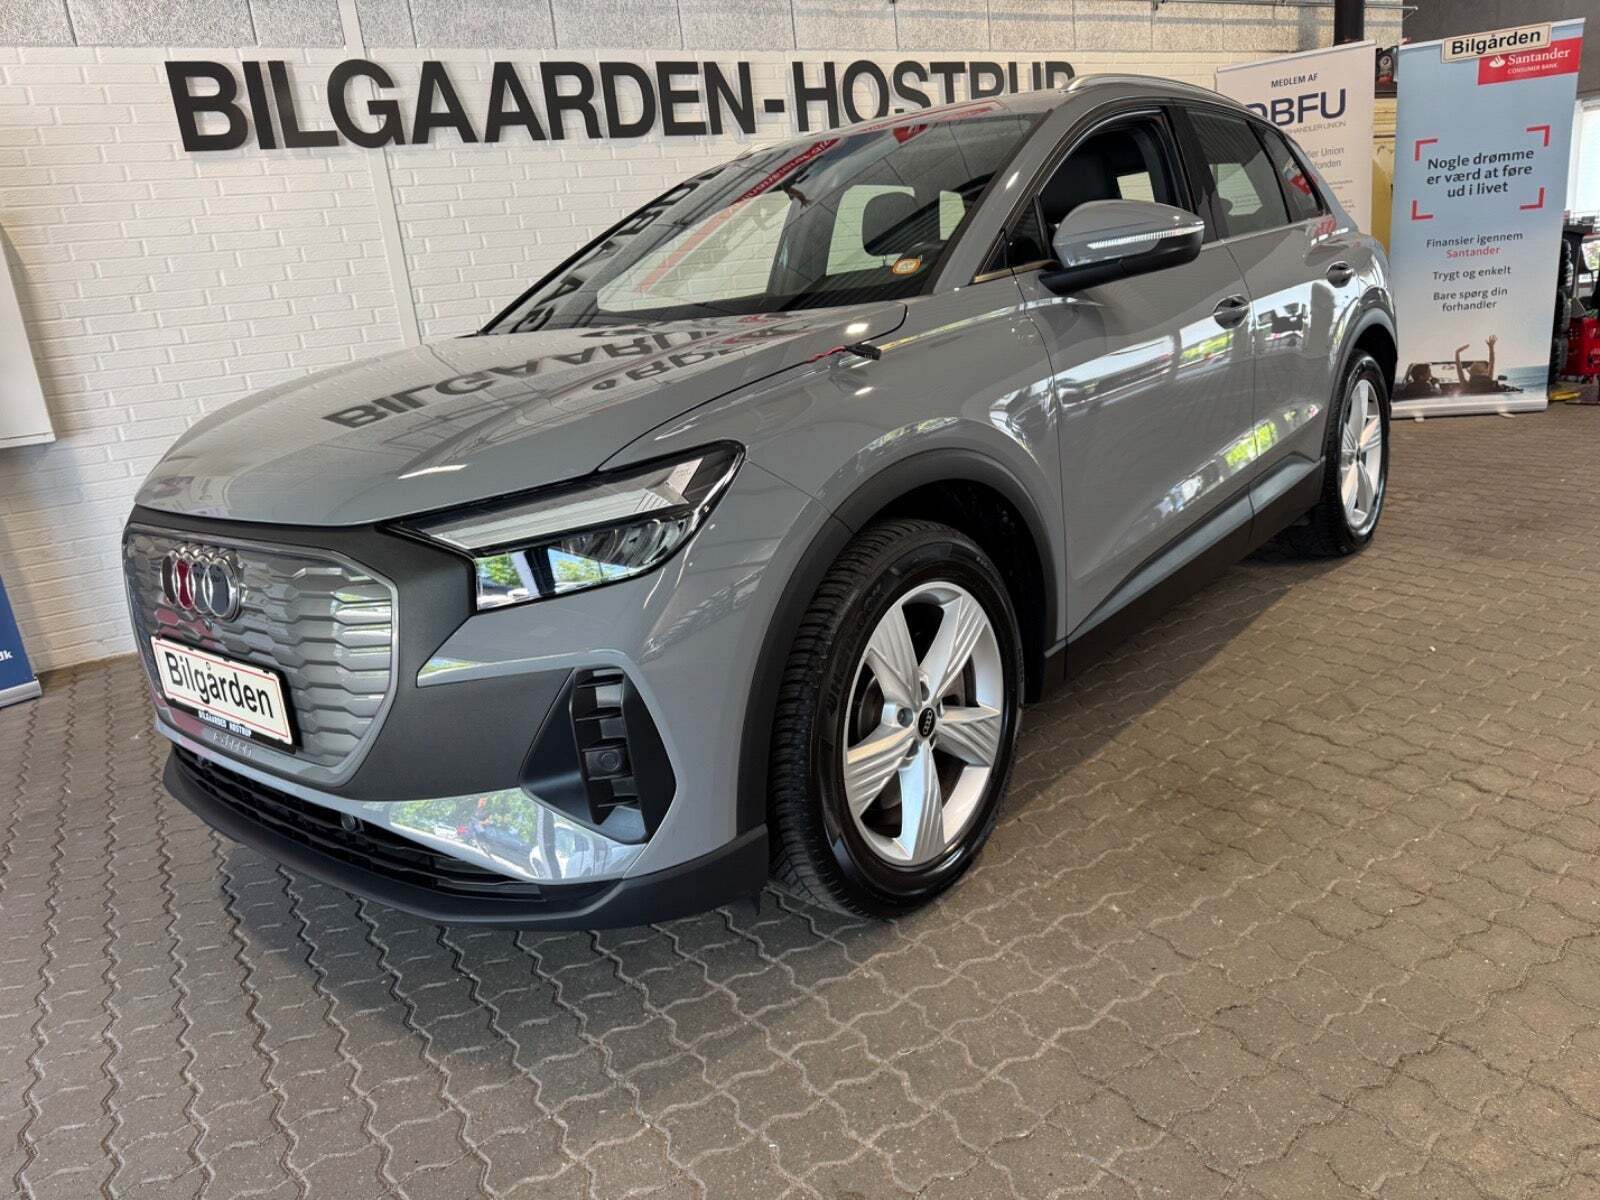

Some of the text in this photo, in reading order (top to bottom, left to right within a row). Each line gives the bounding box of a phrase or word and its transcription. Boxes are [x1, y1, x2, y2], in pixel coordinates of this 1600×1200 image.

[1451, 31, 1541, 55] Bilgården
[1508, 47, 1571, 65] Santander
[1507, 64, 1540, 74] CONSUMER
[1271, 72, 1319, 88] MEDLEM AF
[1427, 150, 1534, 171] Nogle drømme
[1426, 164, 1533, 185] er værd at føre
[1447, 182, 1508, 198] ud i livet
[1426, 232, 1523, 248] Finansier igennem
[1446, 246, 1501, 258] Santander
[1433, 265, 1511, 282] Trygt og enkelt
[1433, 287, 1508, 301] Bare spørg din
[1442, 300, 1497, 312] forhandler
[164, 651, 274, 719] Bilgården
